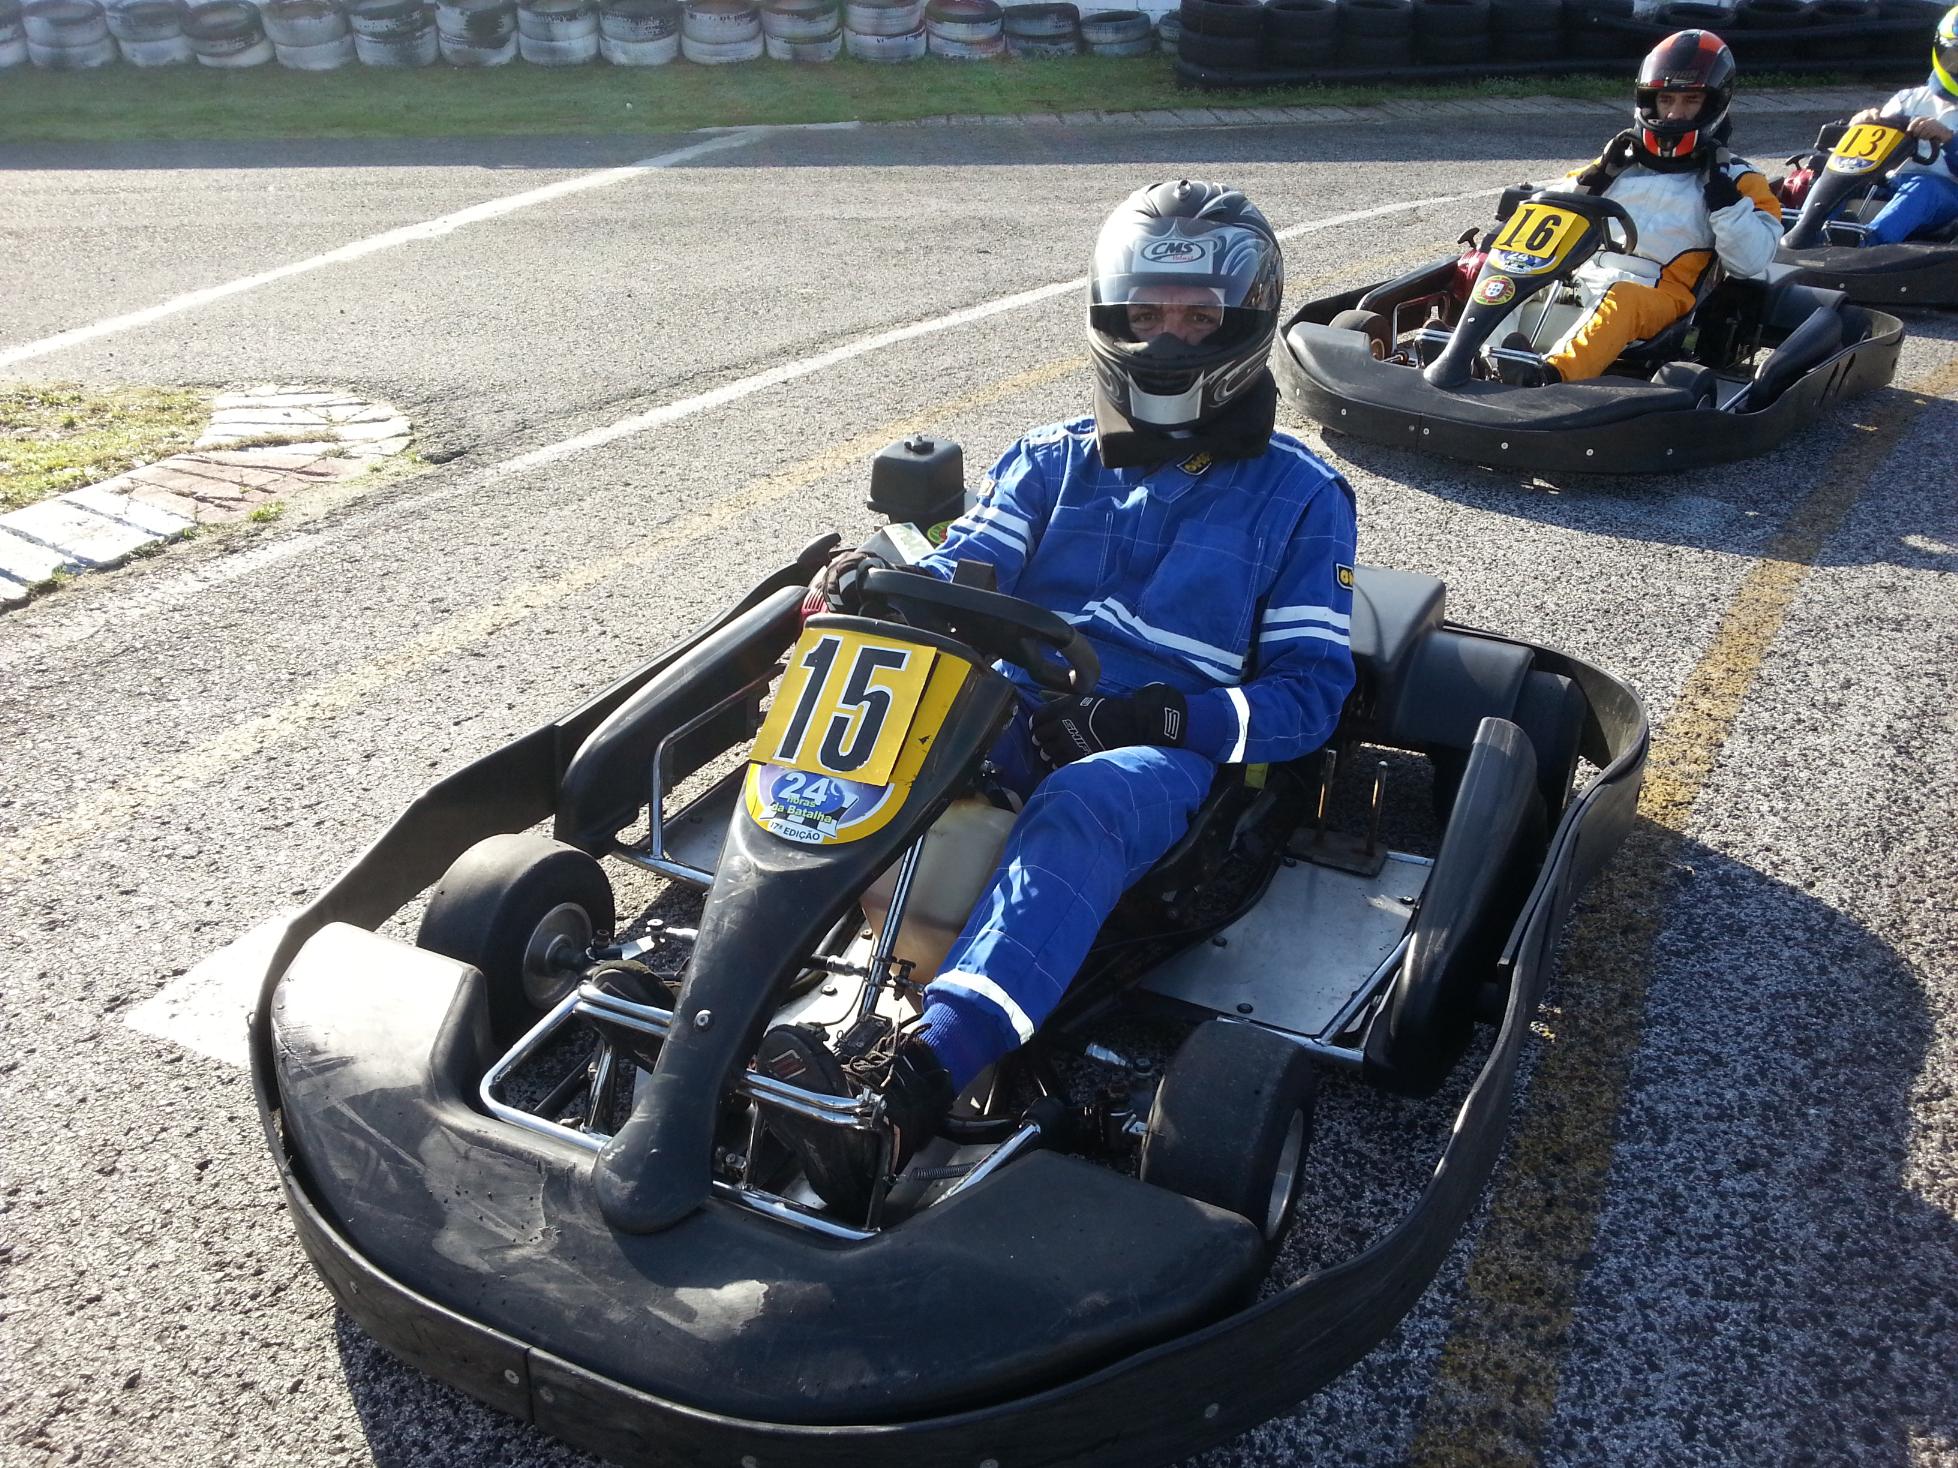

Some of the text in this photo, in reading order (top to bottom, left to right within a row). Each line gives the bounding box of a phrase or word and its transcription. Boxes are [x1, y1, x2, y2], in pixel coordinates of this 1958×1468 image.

[1842, 128, 1886, 157] 13
[1499, 208, 1562, 251] 16
[1152, 242, 1194, 255] CMS
[773, 636, 910, 771] 15
[778, 772, 829, 805] 24
[771, 802, 832, 824] da Batalha
[783, 827, 820, 841] EDIÇÃO
